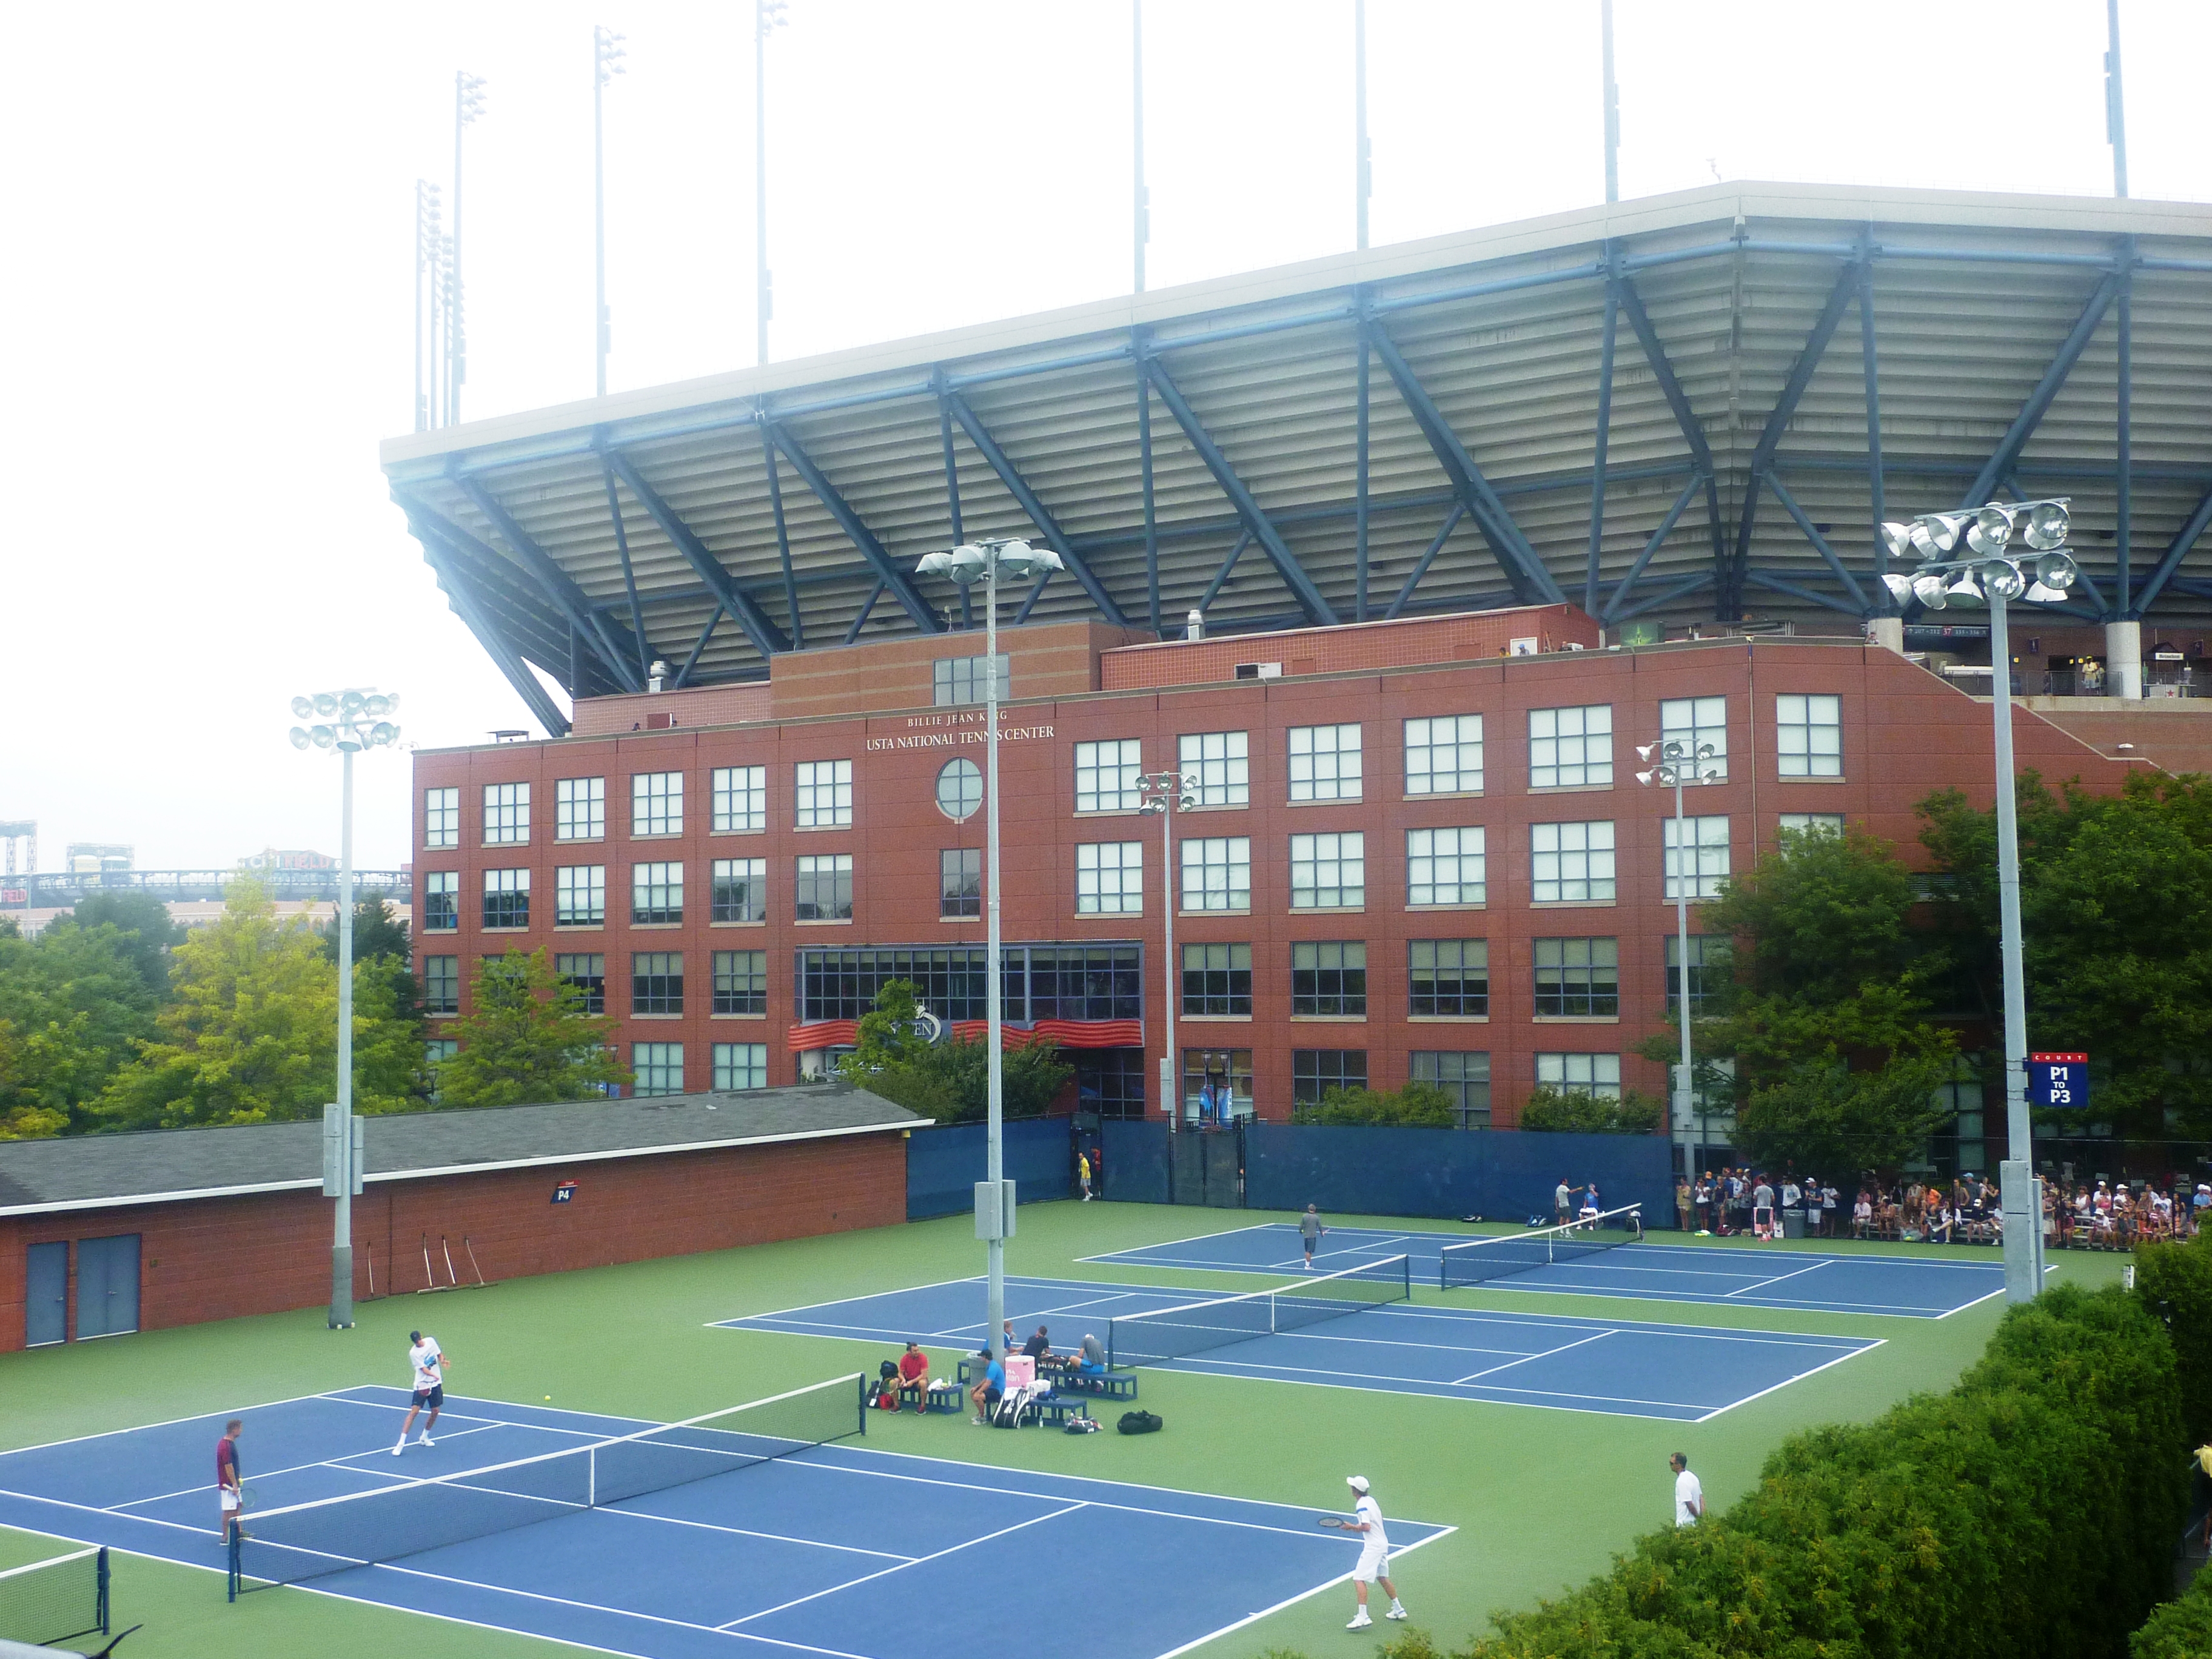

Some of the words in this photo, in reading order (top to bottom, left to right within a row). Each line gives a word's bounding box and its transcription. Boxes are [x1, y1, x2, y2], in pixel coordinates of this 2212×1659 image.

[908, 716, 942, 727] BILLIE
[946, 713, 974, 726] JEAN
[979, 710, 1008, 722] KG
[866, 739, 894, 751] USTA
[897, 732, 956, 748] NATIONAL
[959, 729, 1003, 744] TENNS
[1005, 725, 1055, 741] CENTER
[284, 854, 330, 869] FIELD
[2050, 1066, 2068, 1081] P1
[2050, 1089, 2071, 1104] P3
[558, 1190, 570, 1201] P4
